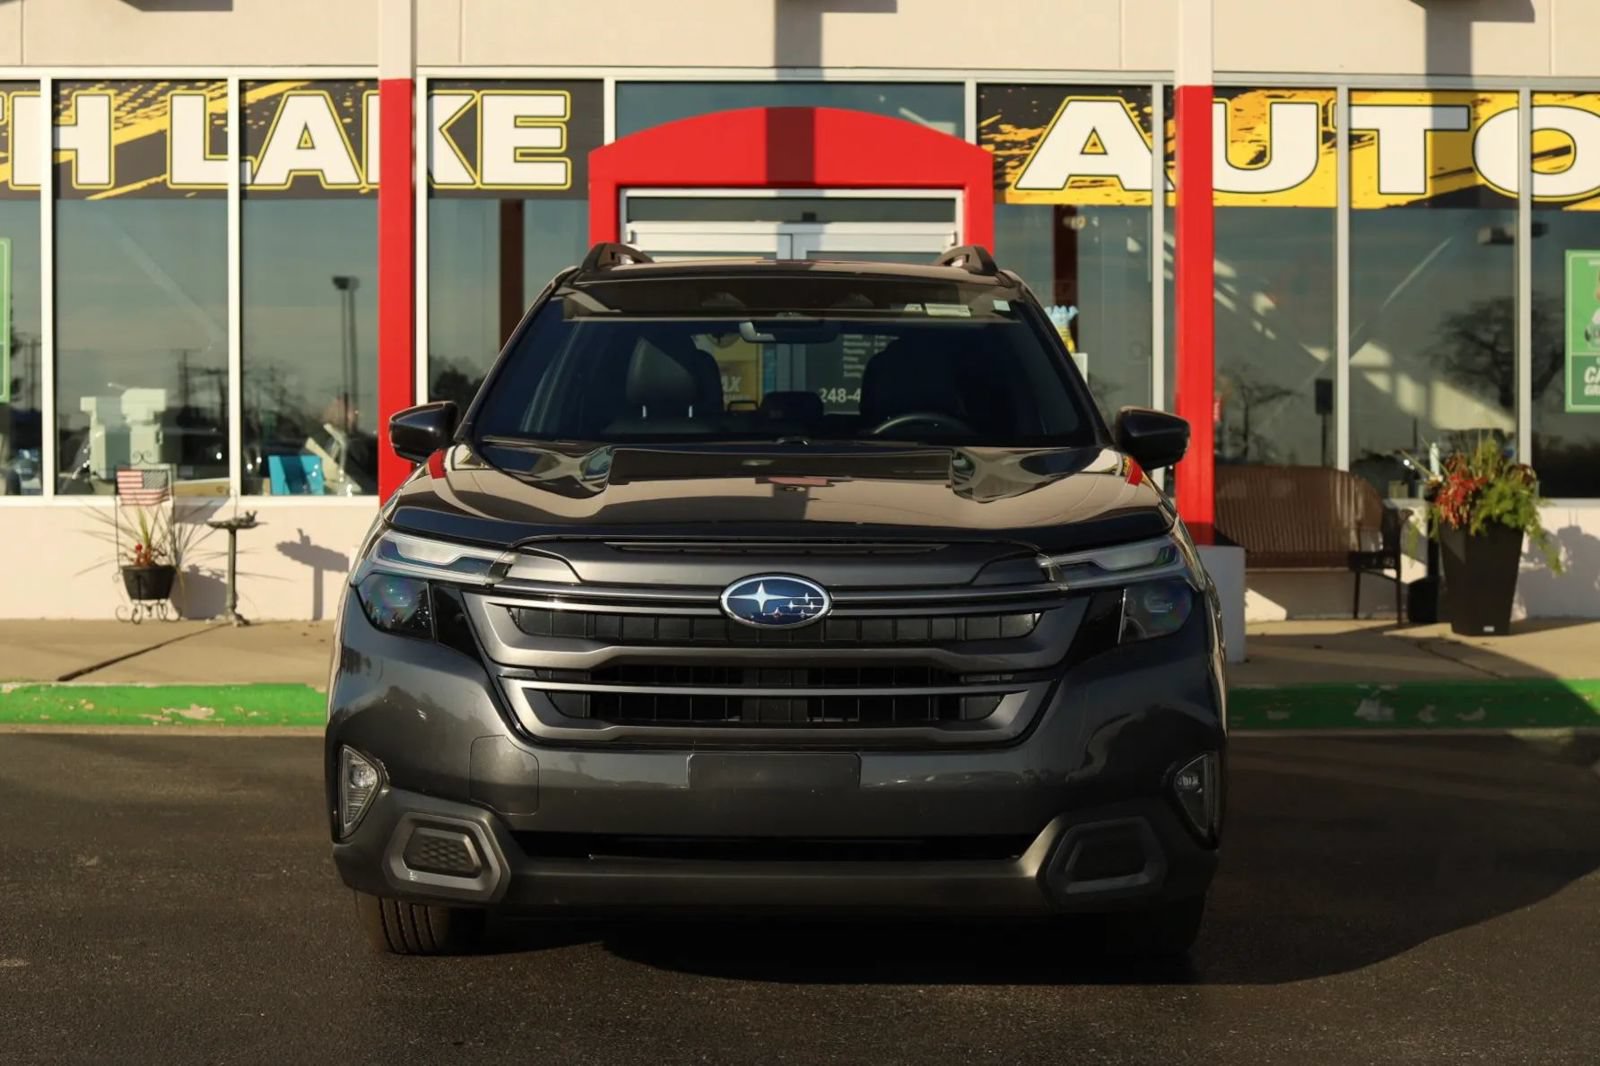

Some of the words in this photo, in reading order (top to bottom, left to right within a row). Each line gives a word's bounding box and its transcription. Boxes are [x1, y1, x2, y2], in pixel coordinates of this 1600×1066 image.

[0, 92, 114, 189] H
[168, 91, 571, 188] LAKE
[1014, 97, 1600, 198] AUTO
